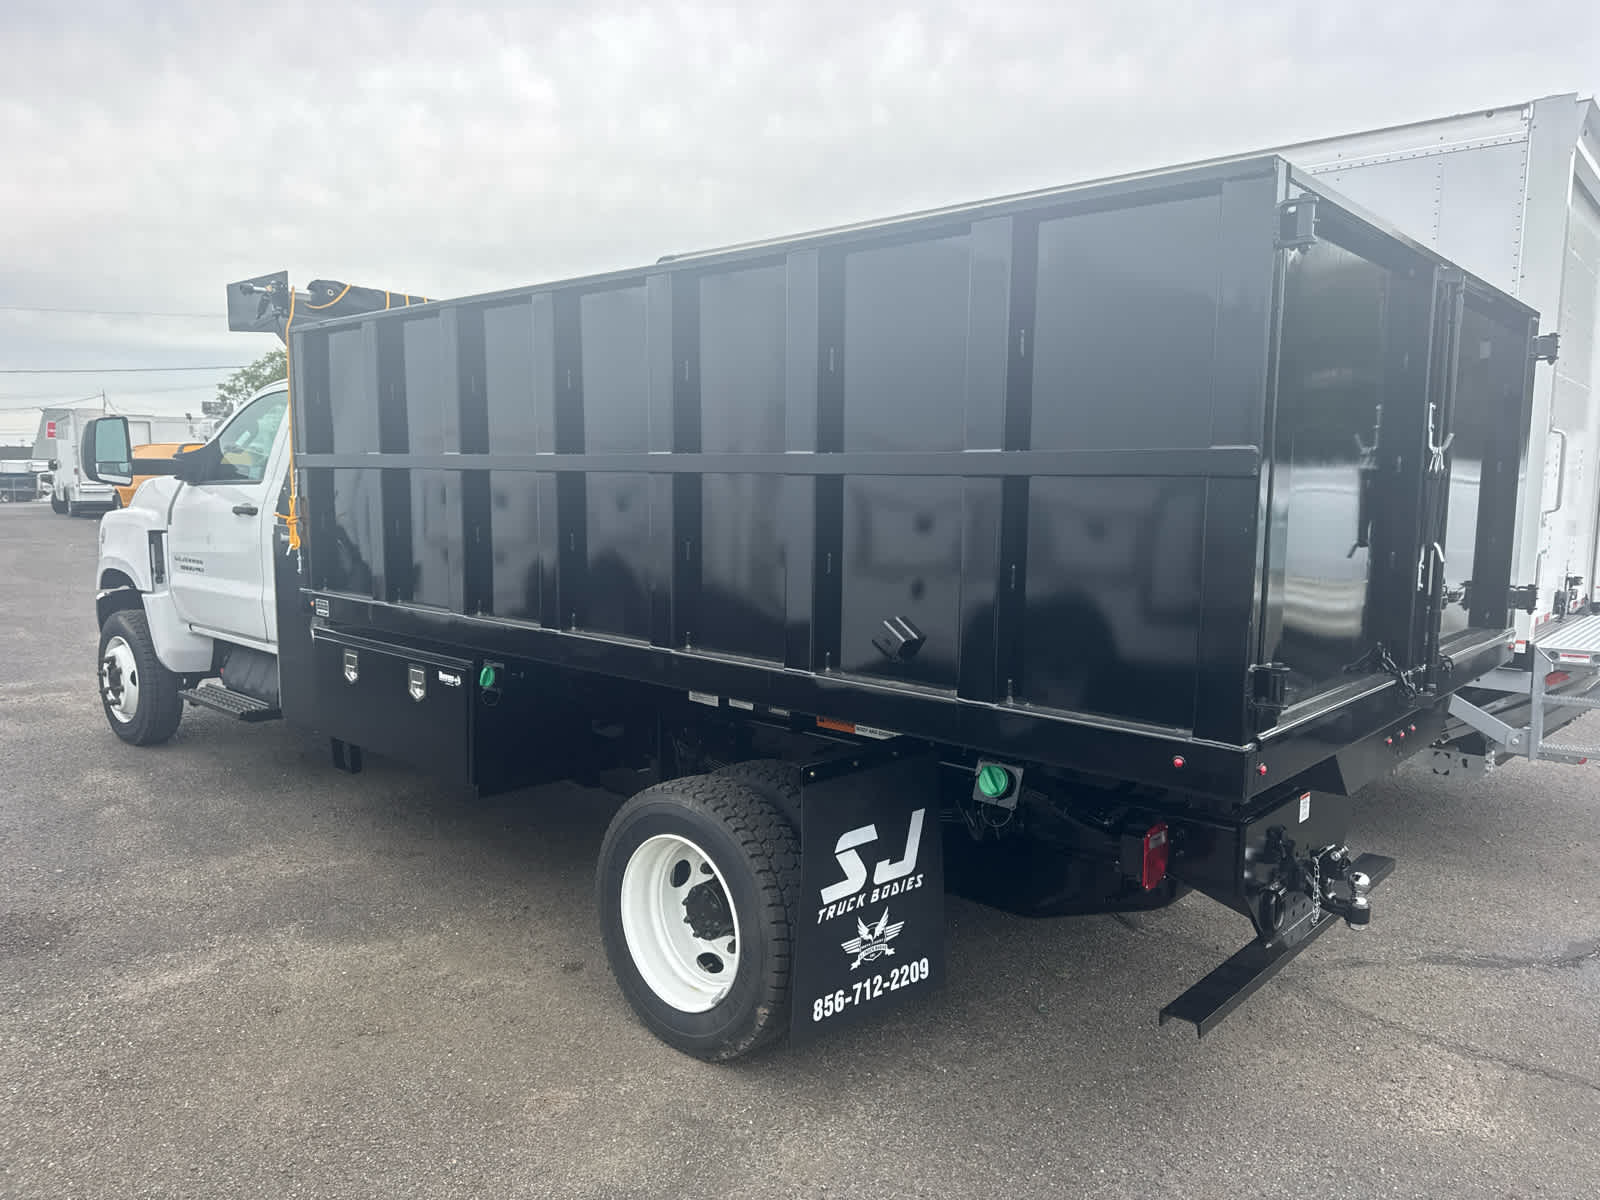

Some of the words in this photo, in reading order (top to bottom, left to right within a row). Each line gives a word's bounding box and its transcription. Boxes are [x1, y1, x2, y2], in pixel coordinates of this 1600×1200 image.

[820, 808, 926, 905] SJ
[817, 893, 866, 924] TRUCK
[870, 874, 925, 904] BODIES
[812, 957, 929, 1022] 856-712-2209
